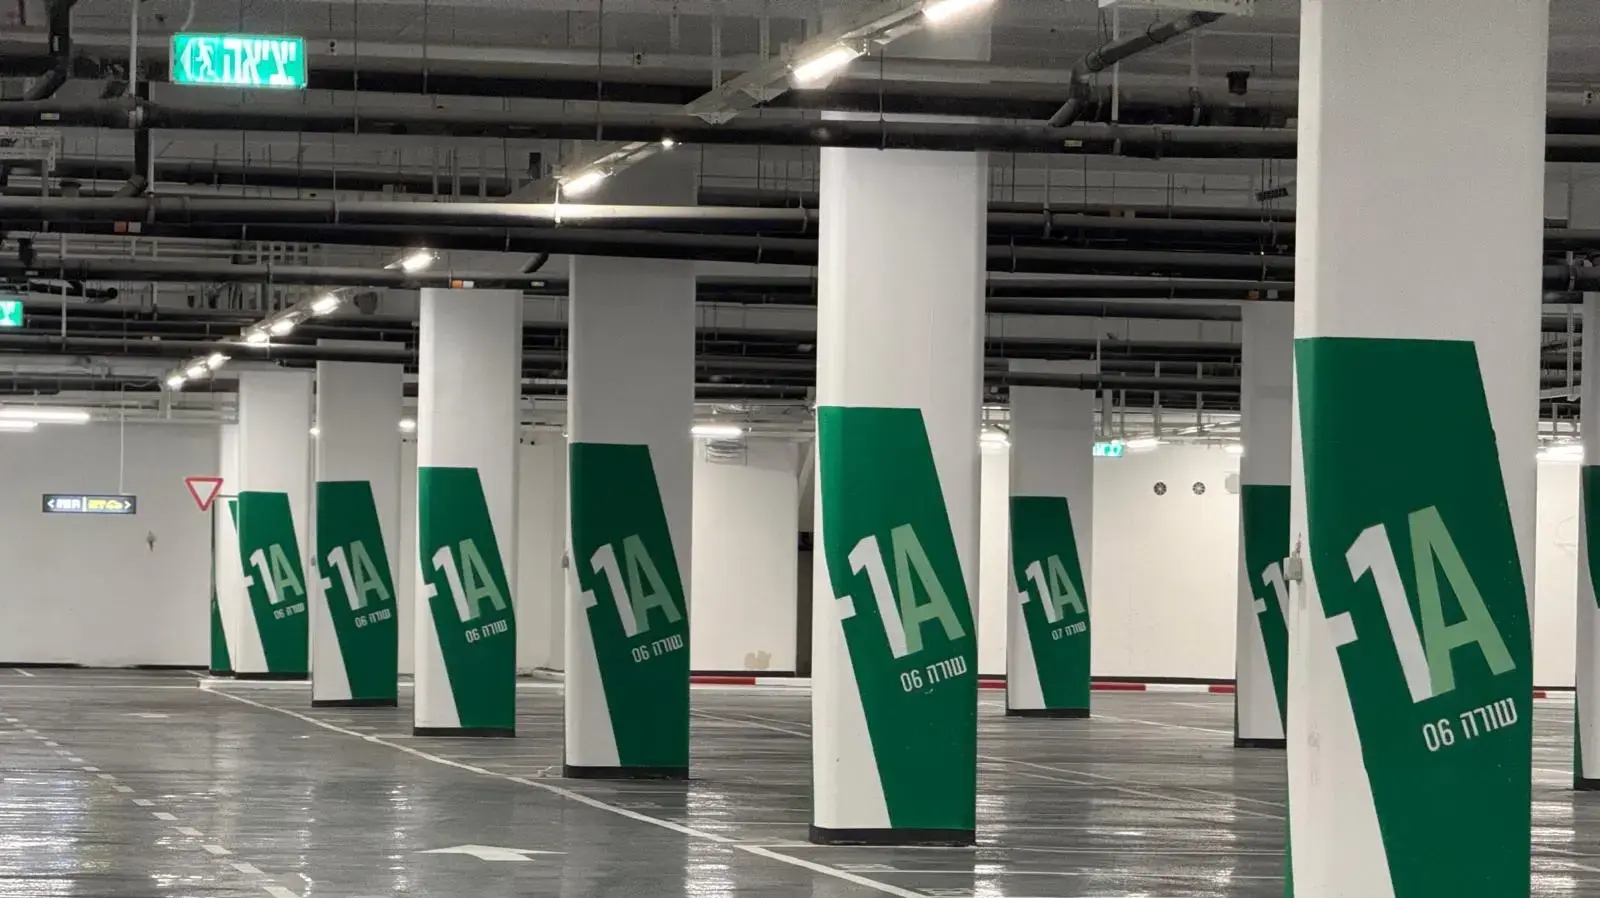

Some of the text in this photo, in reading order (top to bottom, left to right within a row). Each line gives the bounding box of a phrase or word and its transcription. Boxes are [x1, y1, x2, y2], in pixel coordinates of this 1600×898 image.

[223, 38, 297, 86] יציאה
[354, 615, 366, 628] 06
[465, 619, 508, 643] שורה 06
[1051, 621, 1087, 641] שורה 07
[631, 634, 684, 663] שורה 06
[900, 655, 967, 692] שורה 06
[1422, 697, 1518, 752] שורה 06
